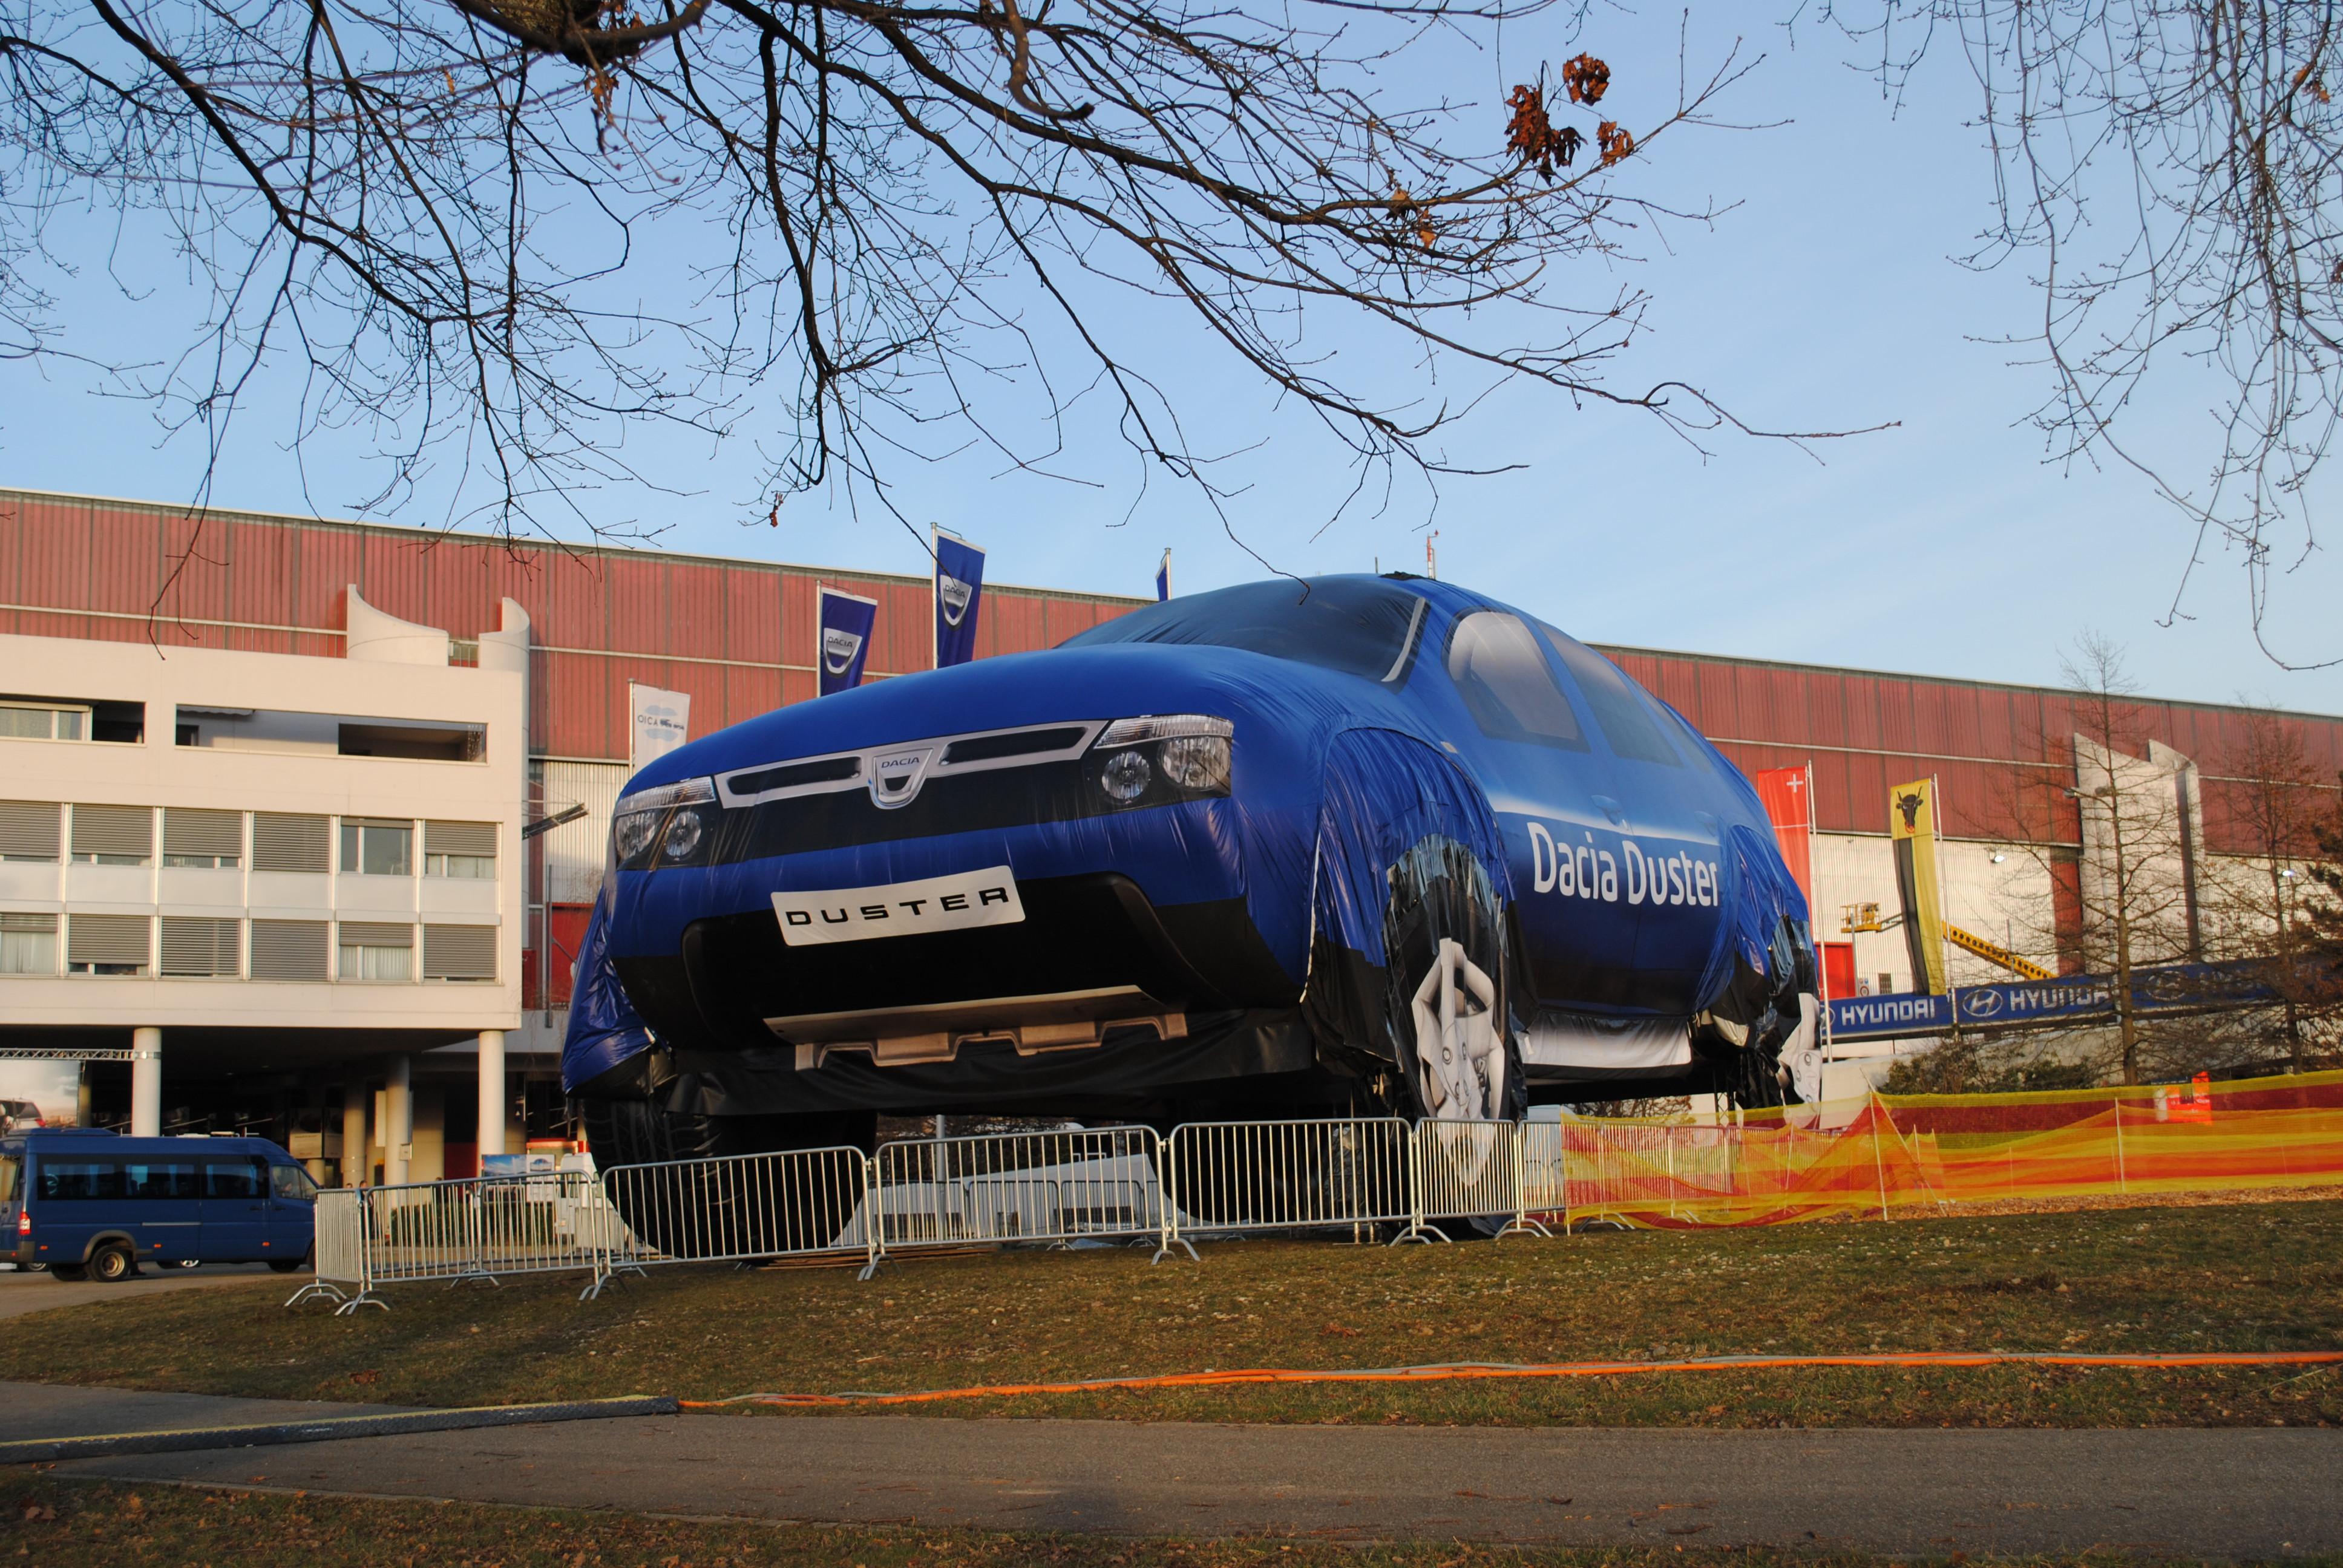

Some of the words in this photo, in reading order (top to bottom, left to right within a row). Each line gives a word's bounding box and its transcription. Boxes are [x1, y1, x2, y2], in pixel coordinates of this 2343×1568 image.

[828, 636, 853, 648] DACIA
[638, 714, 658, 727] OICA
[881, 757, 919, 768] DACIA
[1527, 822, 1617, 902] Dacia
[1622, 840, 1719, 907] Duster
[785, 887, 1009, 926] DUSTER
[2010, 982, 2111, 1011] HYUNDA
[1841, 998, 1935, 1026] HYUNDAI
